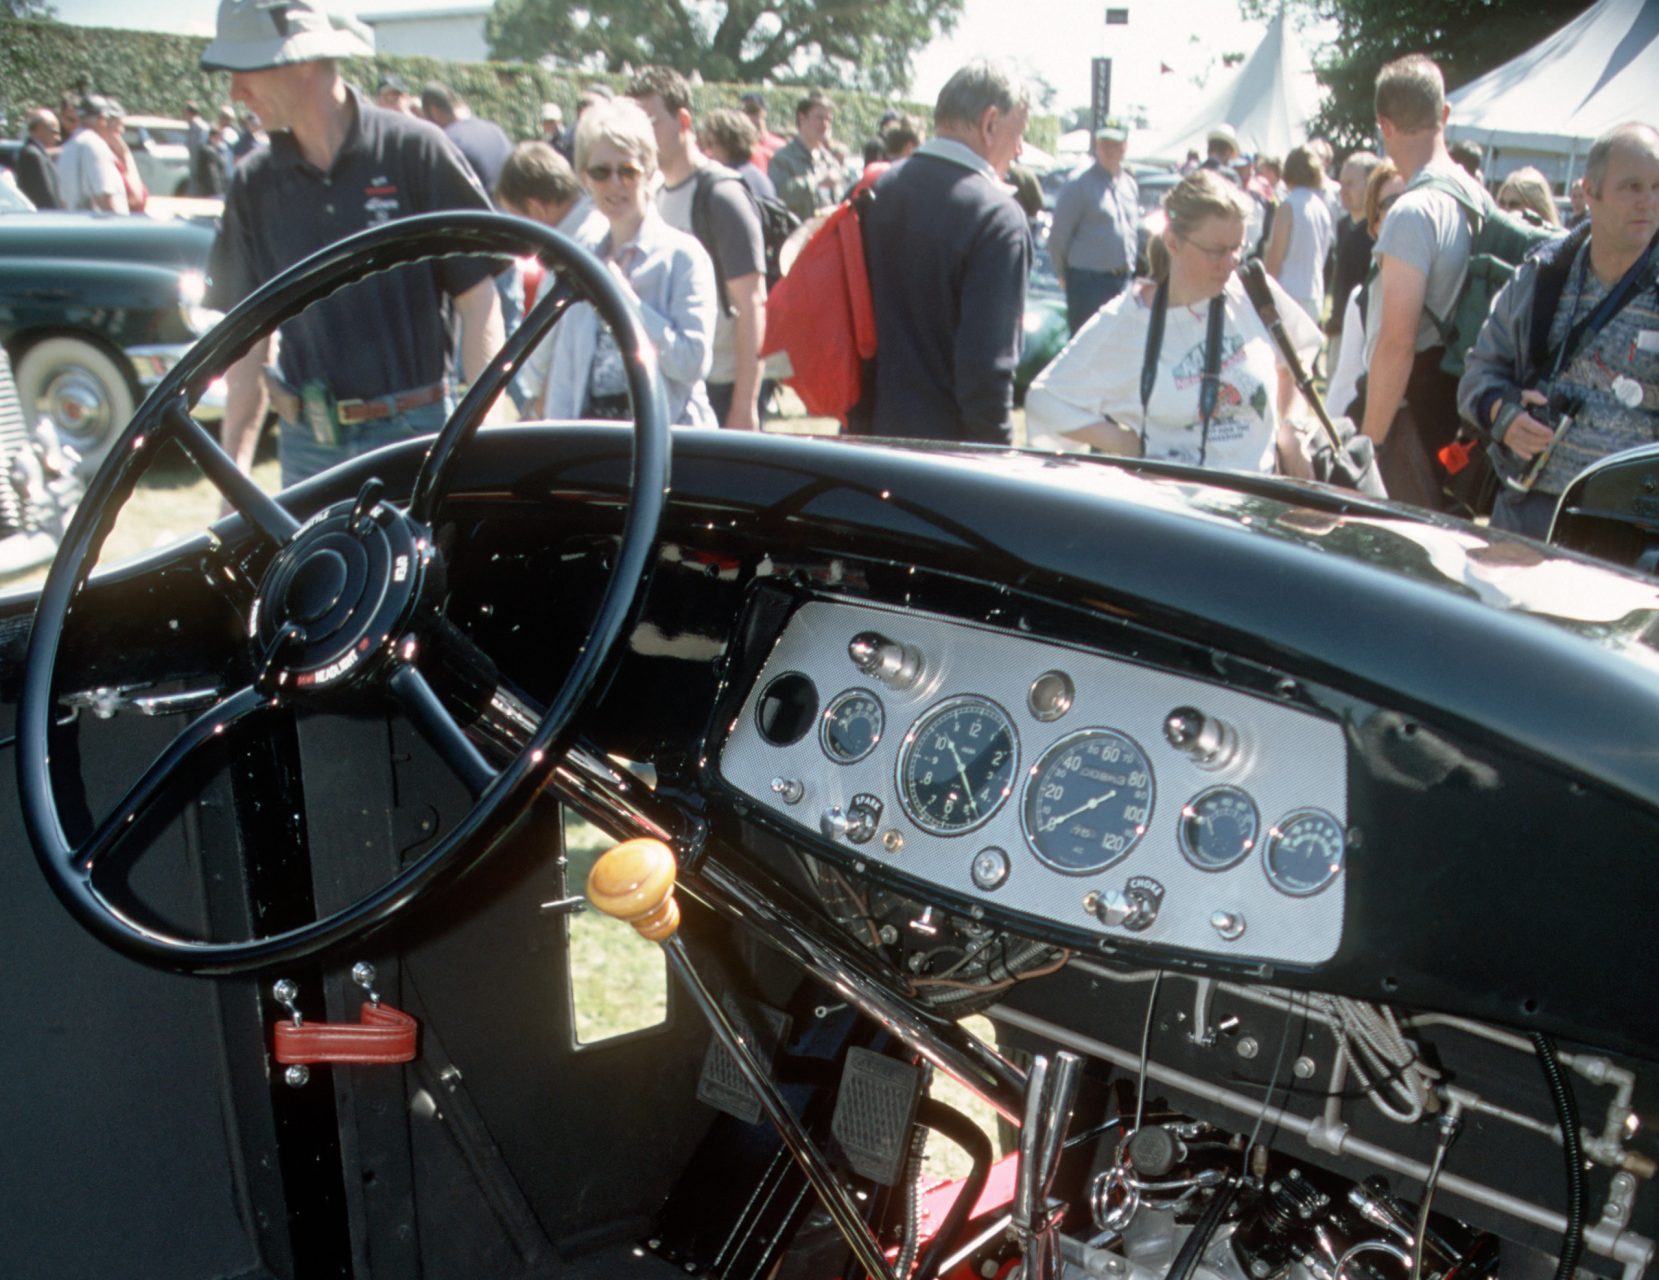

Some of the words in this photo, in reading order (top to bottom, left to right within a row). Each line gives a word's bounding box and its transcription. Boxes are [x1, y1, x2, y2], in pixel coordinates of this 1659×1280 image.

[968, 722, 983, 738] 12
[934, 736, 948, 751] 10
[991, 751, 1004, 766] 2
[1101, 745, 1120, 763] 60
[1063, 756, 1082, 771] 40
[923, 771, 933, 785] 8
[986, 771, 994, 780] 3
[1127, 771, 1147, 788] 80
[980, 788, 990, 801] 4
[1044, 783, 1064, 801] 20
[855, 795, 881, 811] SPARK
[1123, 804, 1146, 823] 100
[1101, 832, 1124, 851] 120
[1130, 879, 1163, 896] CHOKE
